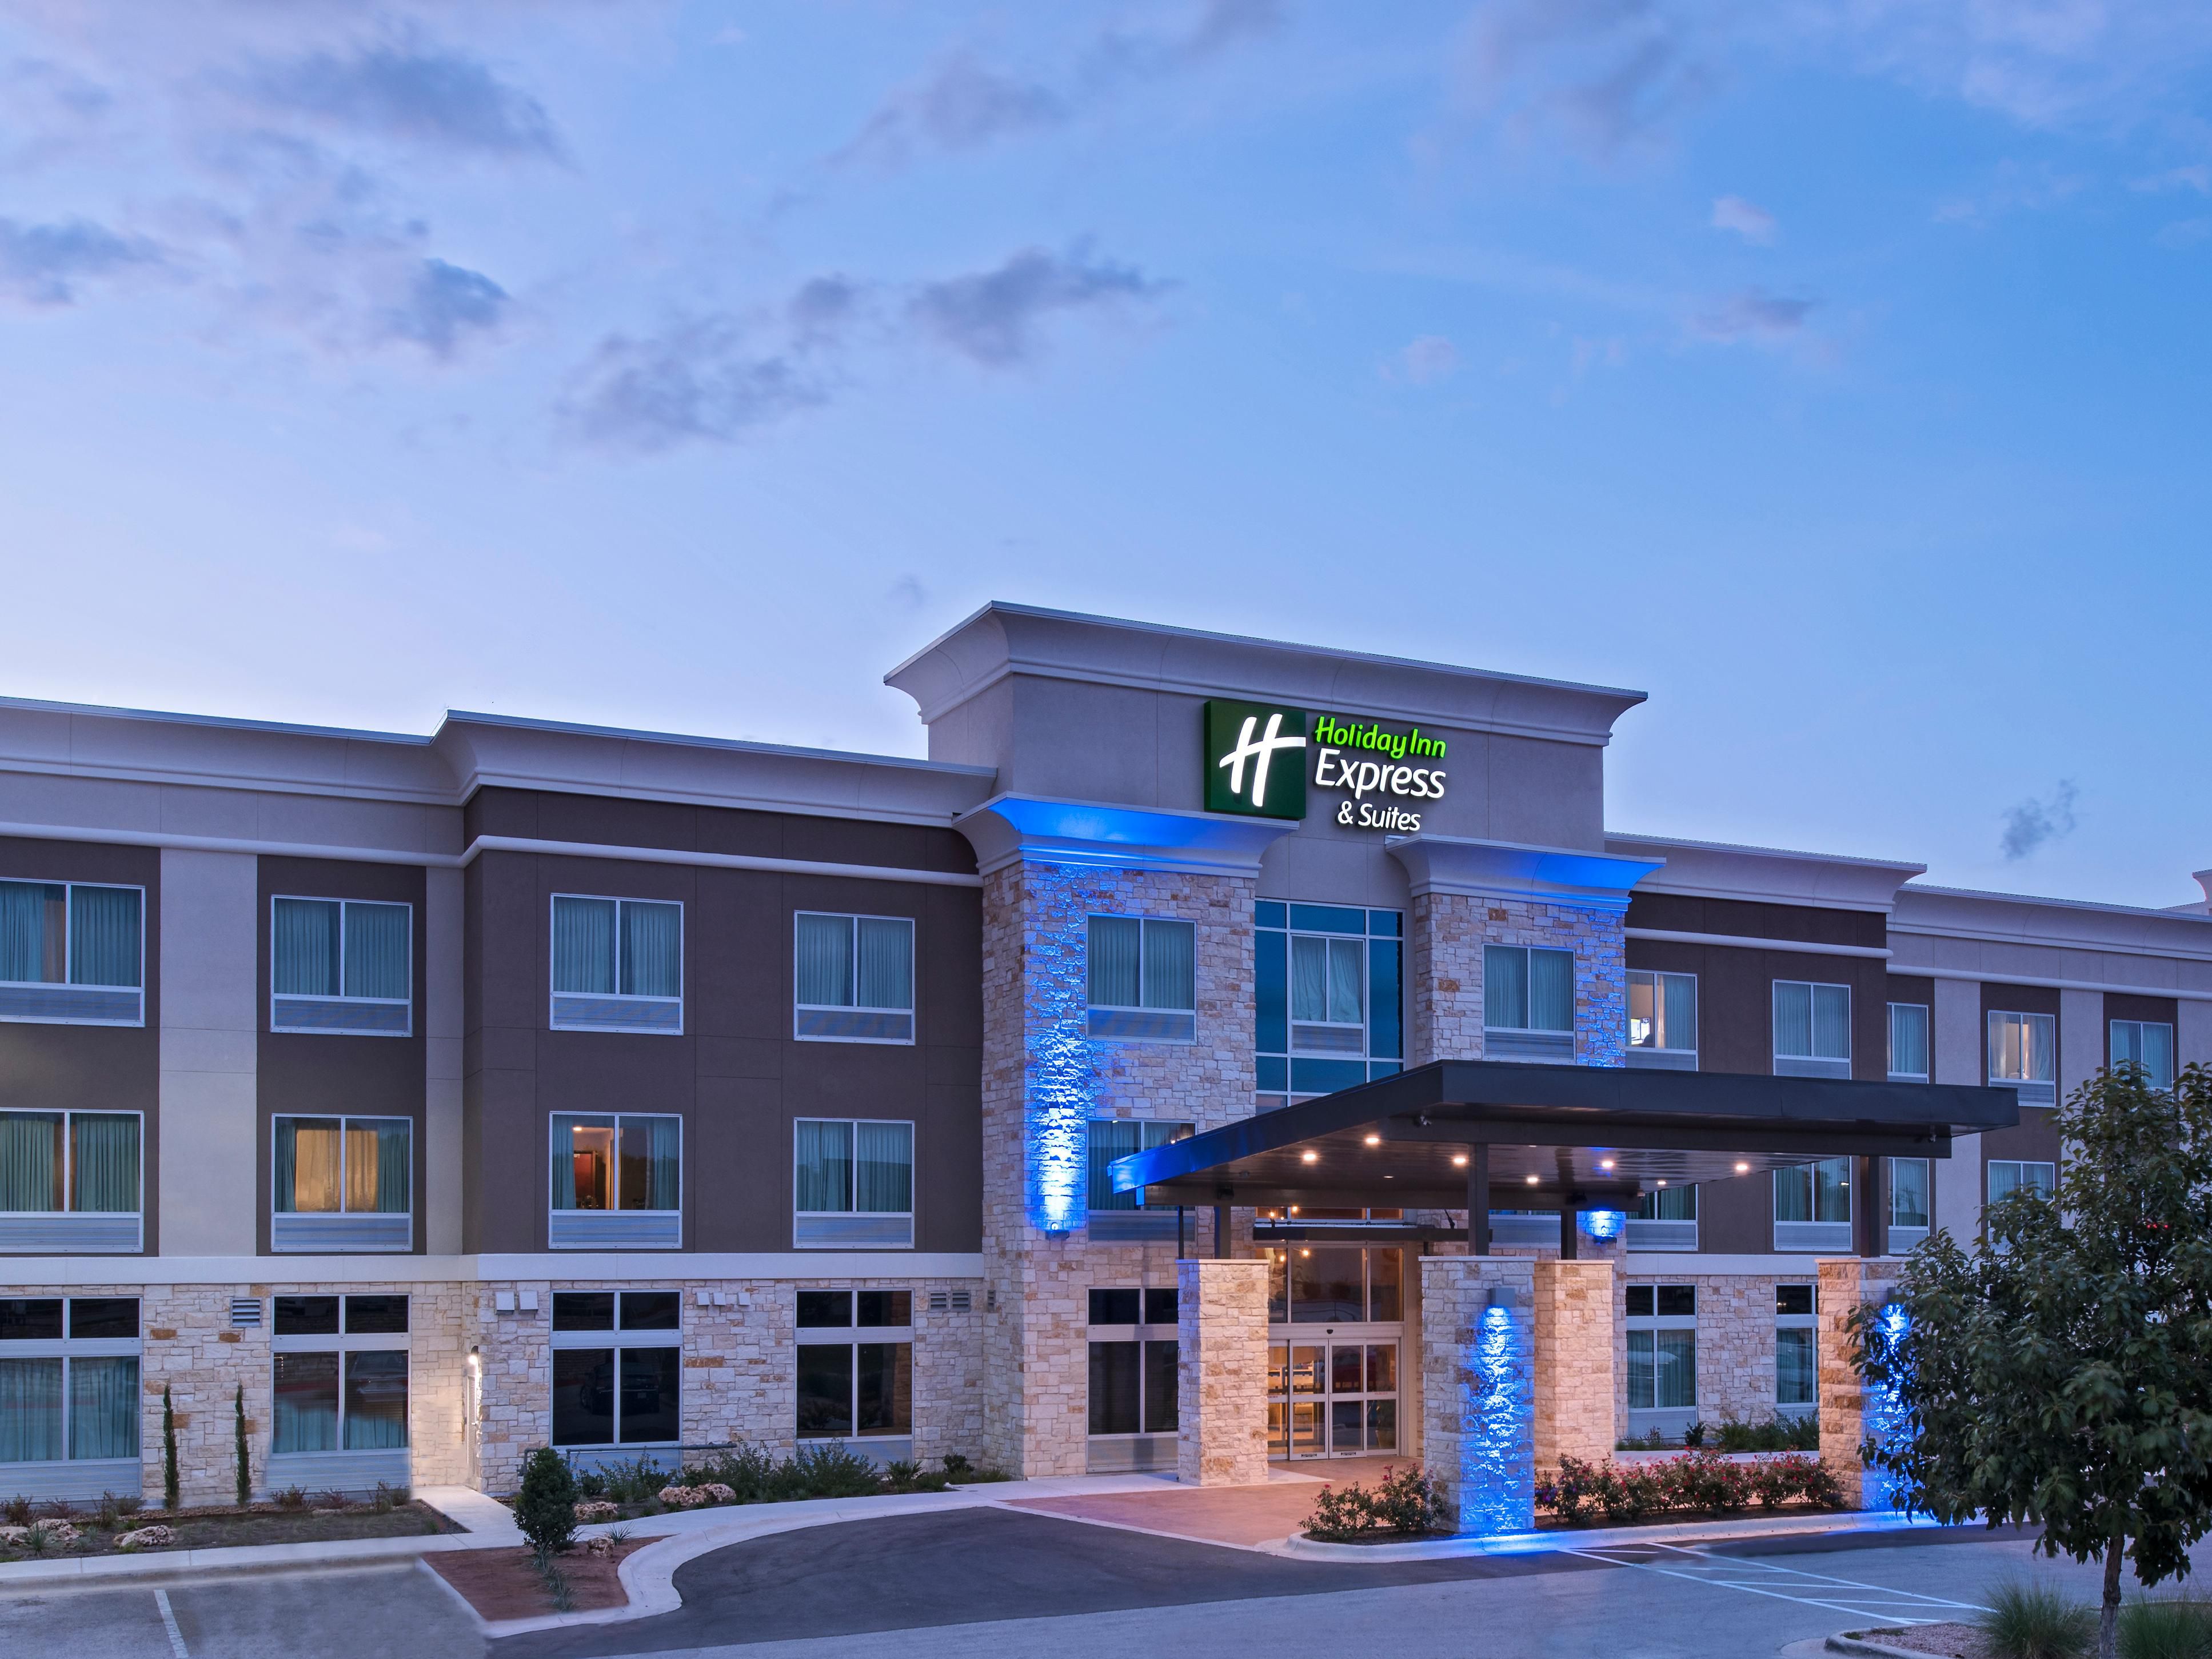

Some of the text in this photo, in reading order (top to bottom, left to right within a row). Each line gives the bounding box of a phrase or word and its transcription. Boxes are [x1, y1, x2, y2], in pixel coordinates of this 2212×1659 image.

[1315, 716, 1447, 759] Holiday Inn
[1315, 747, 1447, 799] Express
[1337, 801, 1421, 831] & Suites
